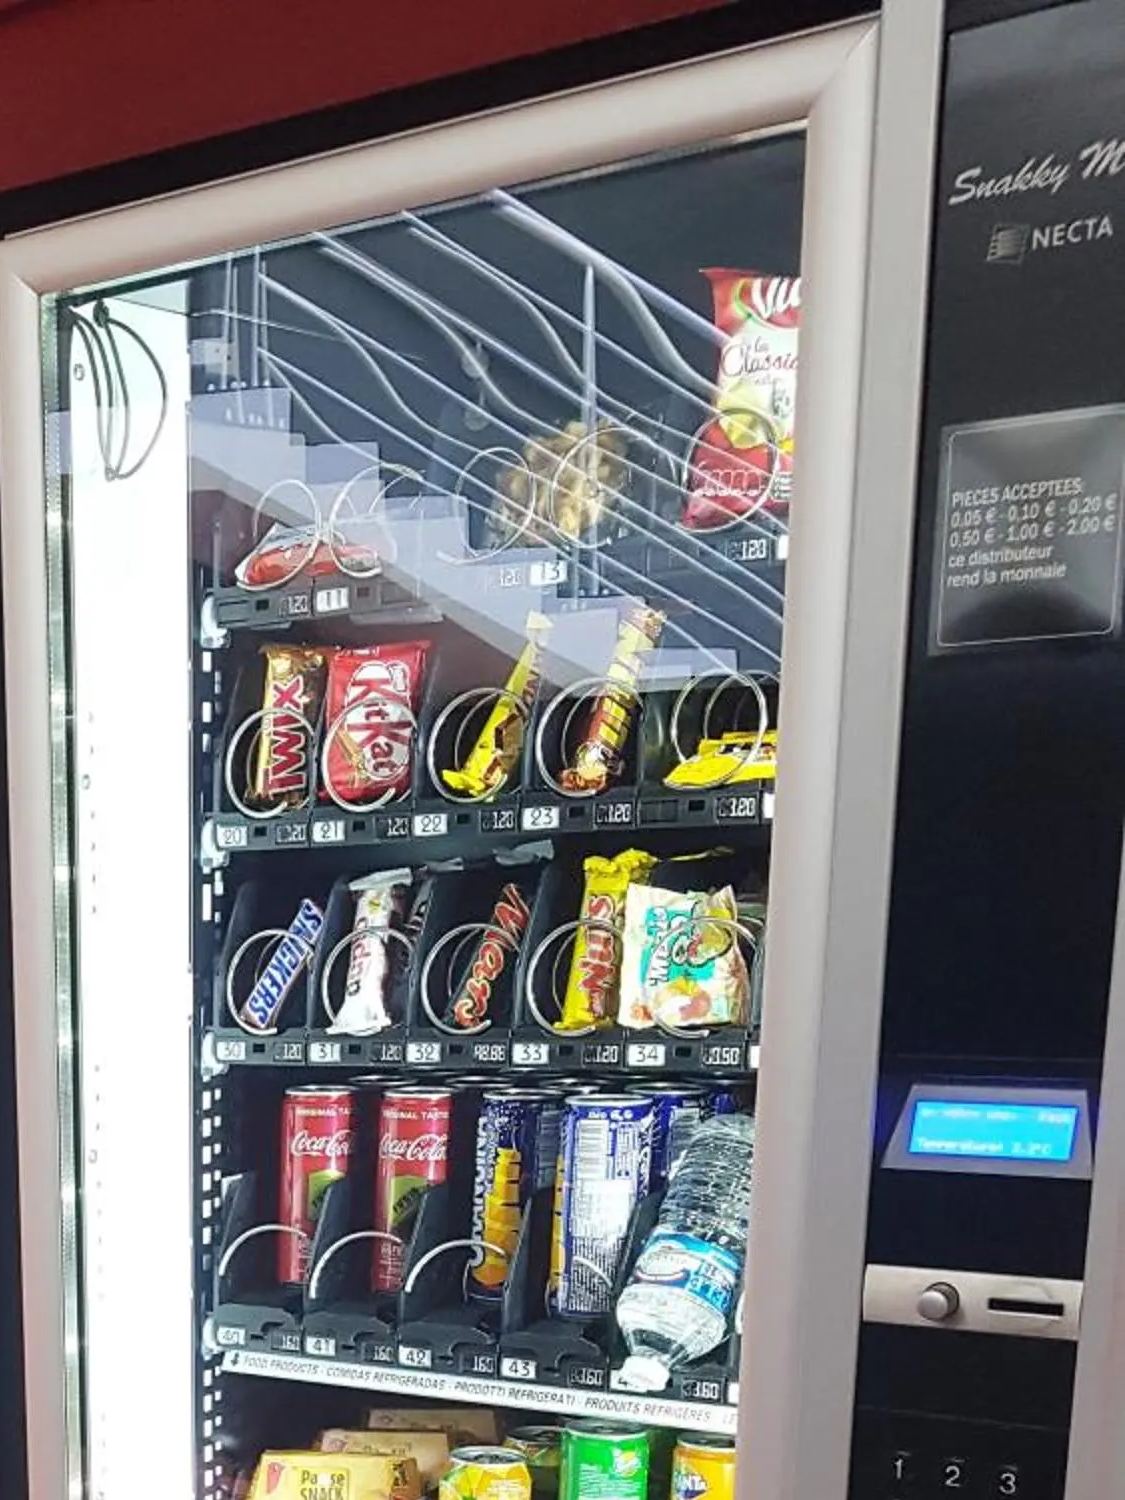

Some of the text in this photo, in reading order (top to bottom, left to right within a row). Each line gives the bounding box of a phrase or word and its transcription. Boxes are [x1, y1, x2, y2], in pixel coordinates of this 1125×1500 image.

[948, 153, 1071, 206] Snakky
[1032, 216, 1114, 251] NECTA
[968, 545, 1055, 566] distributeur
[269, 675, 307, 796] TWIX
[224, 828, 243, 844] 20
[320, 822, 338, 841] 21
[420, 816, 442, 834] 22
[530, 808, 553, 826] 23
[247, 900, 324, 1026] SNICKERS
[414, 1044, 436, 1061] 32
[520, 1044, 542, 1062] 33
[635, 1045, 659, 1063] 34
[379, 1133, 448, 1162] Coca-Cola
[312, 1337, 330, 1352] 41
[406, 1350, 426, 1365] 42
[507, 1361, 531, 1377] 43
[301, 1469, 345, 1486] Pase
[893, 1458, 1017, 1495] 1 2 3
